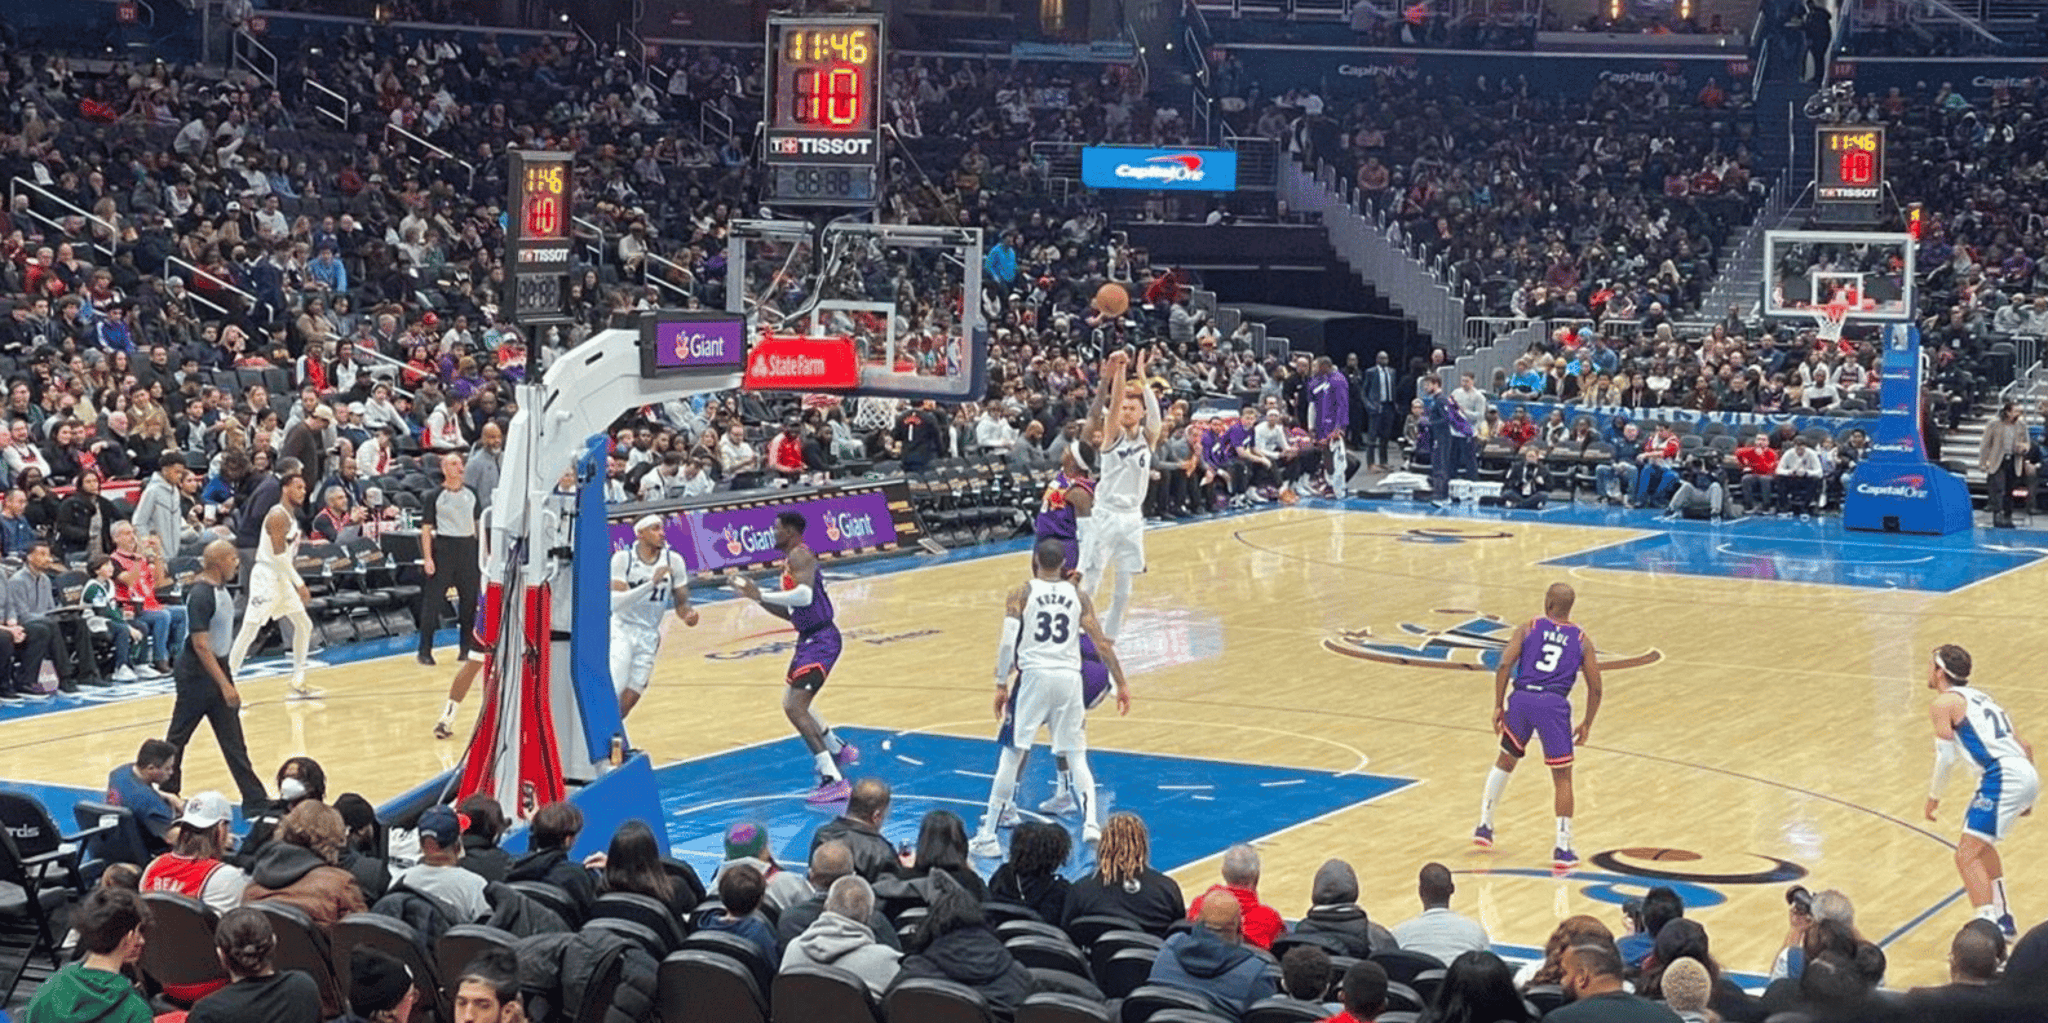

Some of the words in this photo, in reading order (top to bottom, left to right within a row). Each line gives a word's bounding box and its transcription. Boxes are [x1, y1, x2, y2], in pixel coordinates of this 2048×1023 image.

[794, 30, 868, 64] 11:46
[812, 68, 857, 125] 10
[798, 137, 873, 155] TISSOT
[1842, 153, 1870, 182] 10
[536, 197, 555, 233] 10
[533, 248, 570, 262] TISSOT
[690, 332, 724, 358] Giant
[740, 525, 777, 554] Giant
[838, 512, 875, 539] Giant
[1034, 611, 1070, 644] 33
[1535, 643, 1563, 673] 3
